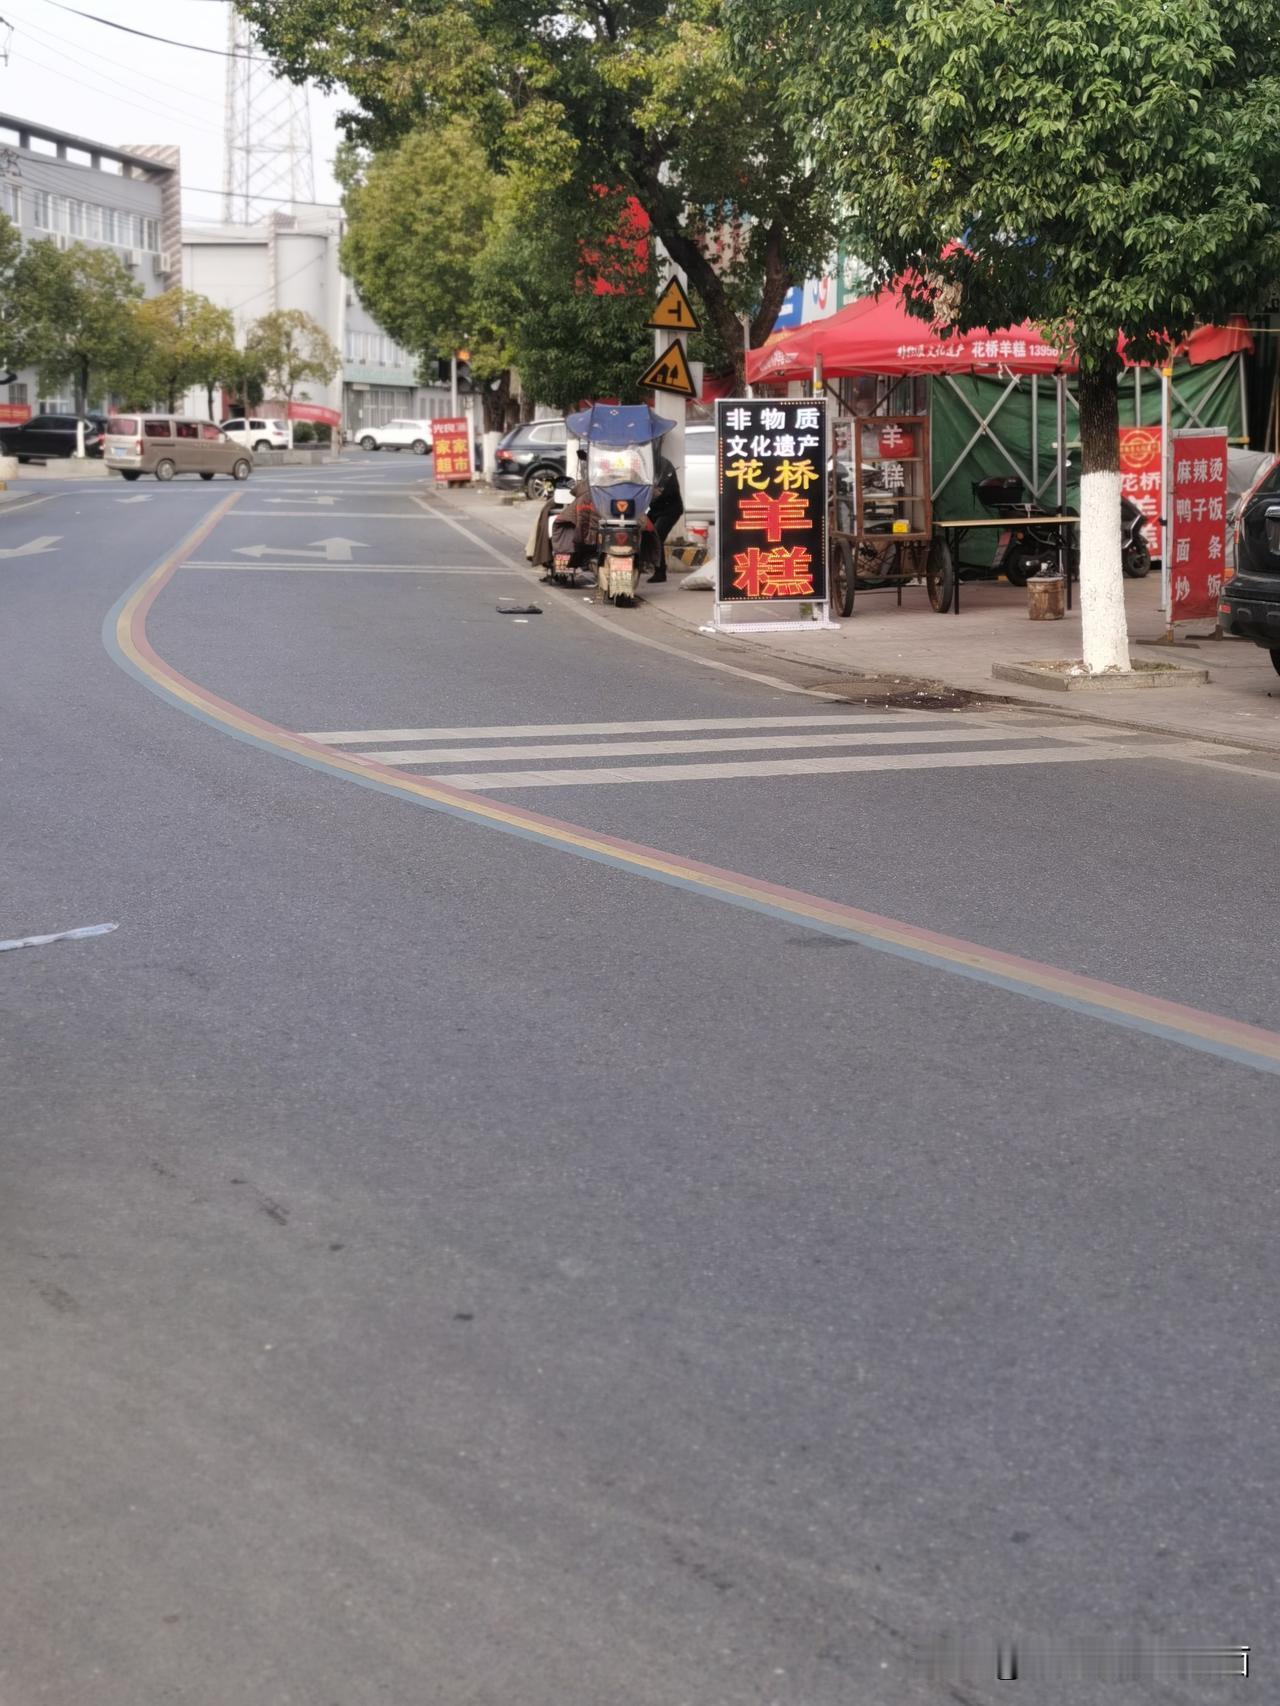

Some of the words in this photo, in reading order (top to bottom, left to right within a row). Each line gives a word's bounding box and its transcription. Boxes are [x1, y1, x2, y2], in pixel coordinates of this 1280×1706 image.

[971, 340, 1027, 358] 花桥羊糕
[1029, 345, 1060, 357] 13956
[726, 408, 820, 431] 非物质
[726, 434, 819, 458] 文化遗产
[725, 459, 819, 490] 花桥
[1120, 471, 1161, 492] 花桥
[1177, 457, 1223, 484] 麻辣烫
[1176, 497, 1223, 523] 鸭子饭
[1176, 535, 1222, 562] 面条
[1175, 574, 1221, 602] 炒饭
